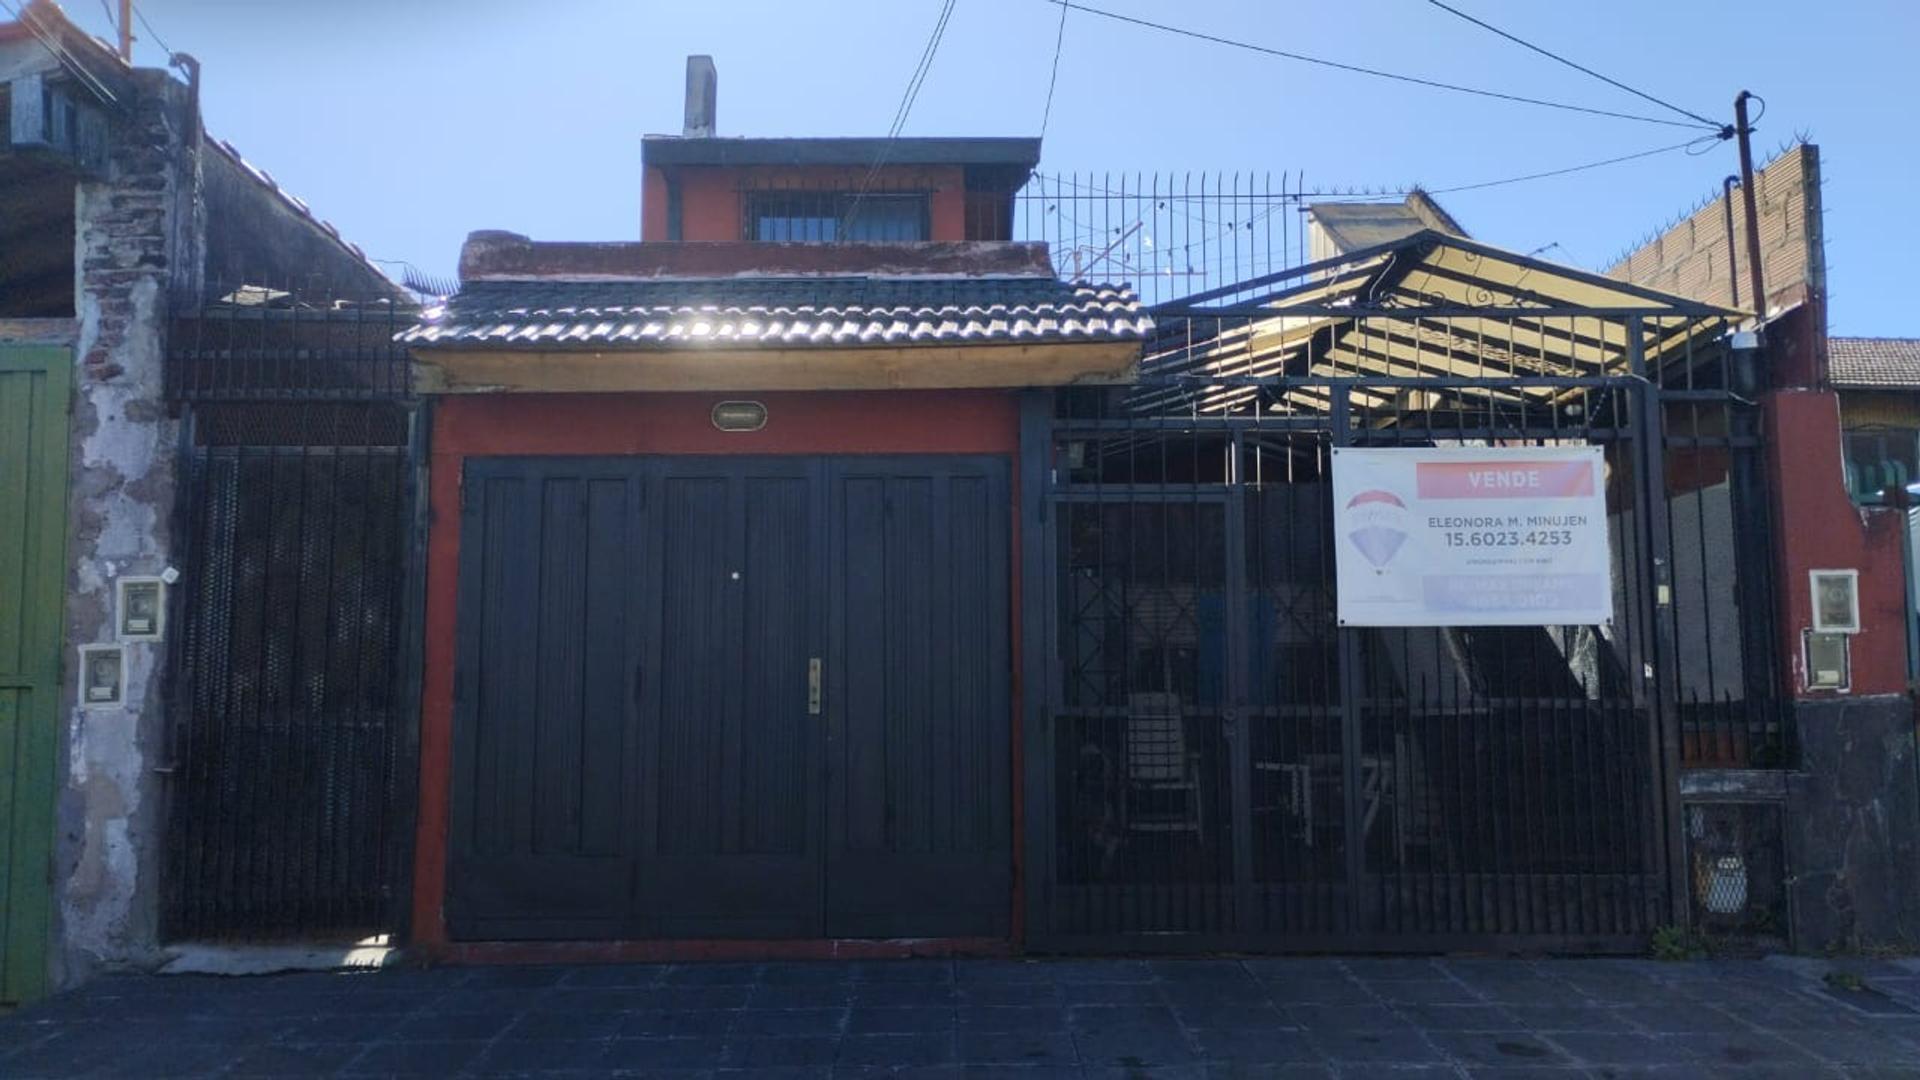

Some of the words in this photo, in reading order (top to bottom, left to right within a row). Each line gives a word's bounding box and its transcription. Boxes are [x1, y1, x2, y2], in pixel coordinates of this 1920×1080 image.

[1468, 471, 1540, 488] VENDE
[1428, 516, 1503, 528] ELEONORA
[1508, 516, 1523, 527] M.
[1527, 515, 1587, 527] MINUJEN
[1445, 530, 1572, 547] 15.6023.4253
